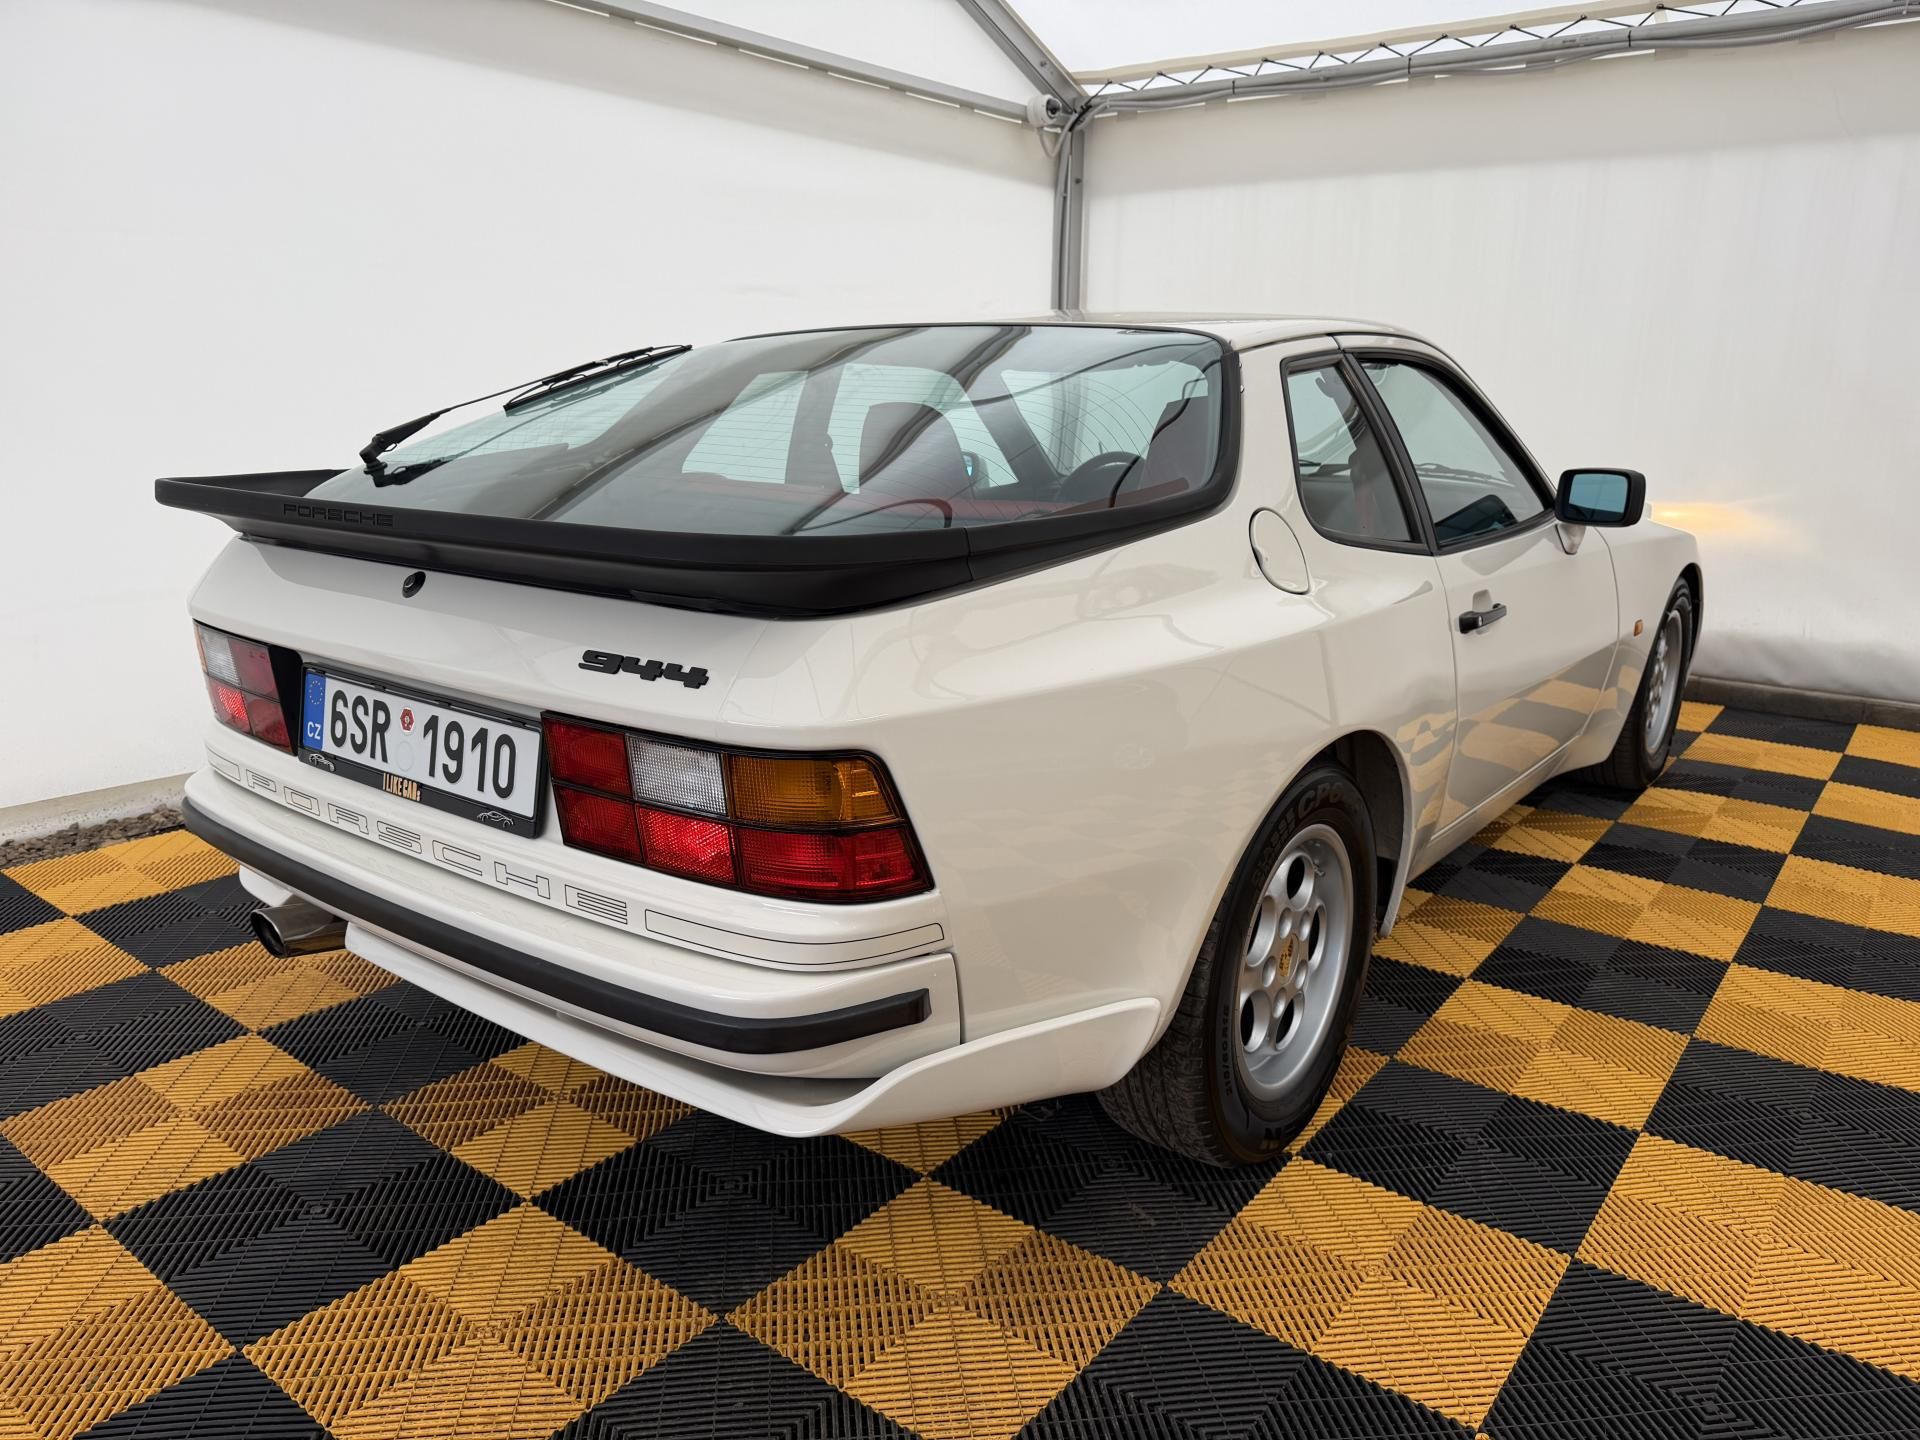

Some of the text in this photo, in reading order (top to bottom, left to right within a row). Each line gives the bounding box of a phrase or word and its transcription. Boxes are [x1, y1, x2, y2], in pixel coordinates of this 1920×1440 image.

[284, 503, 393, 527] PORSCHE
[578, 650, 709, 689] 944
[307, 721, 321, 740] CZ
[330, 690, 516, 799] 6SR 1910
[386, 774, 402, 796] LIKE
[245, 769, 628, 925] PORSCHE
